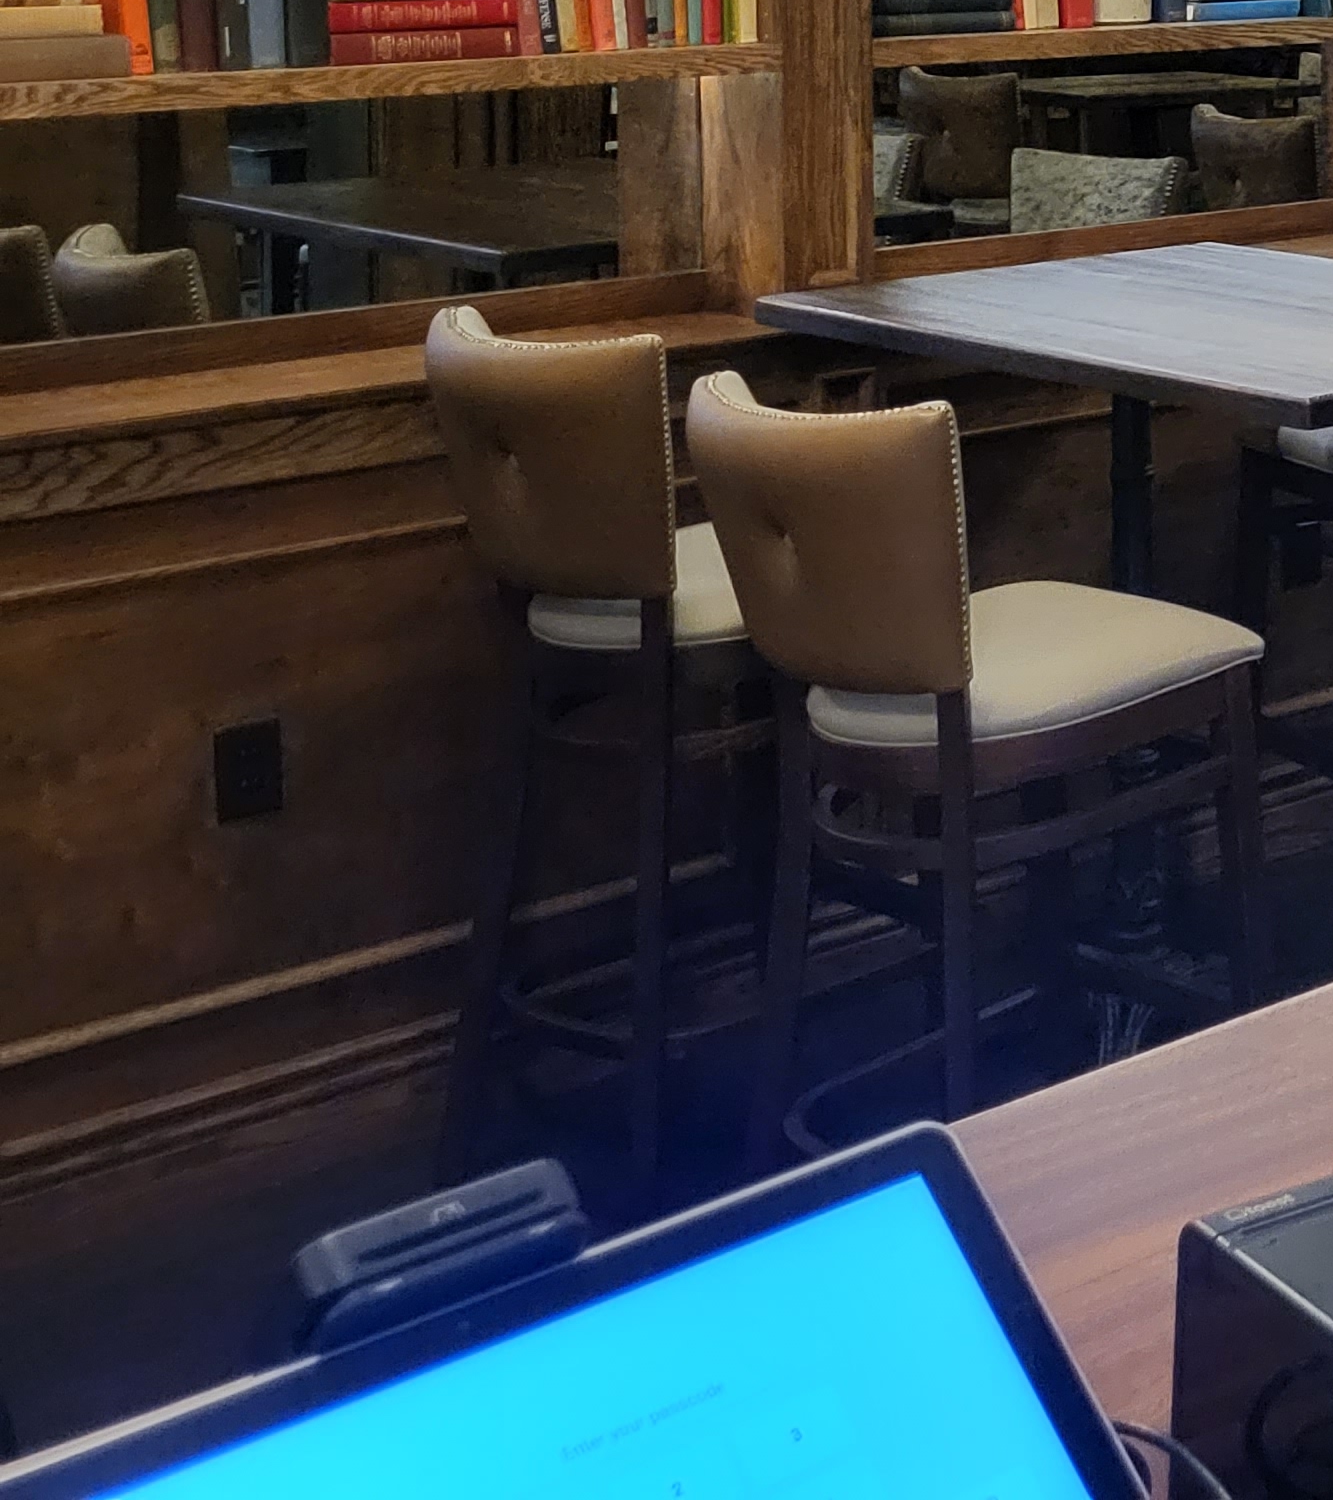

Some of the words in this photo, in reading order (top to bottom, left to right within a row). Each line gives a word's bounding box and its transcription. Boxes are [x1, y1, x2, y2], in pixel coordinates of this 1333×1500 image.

[561, 1431, 605, 1463] Enter
[608, 1417, 644, 1444] your
[648, 1380, 725, 1426] passcode
[789, 1426, 804, 1443] 3
[671, 1480, 684, 1498] 2
